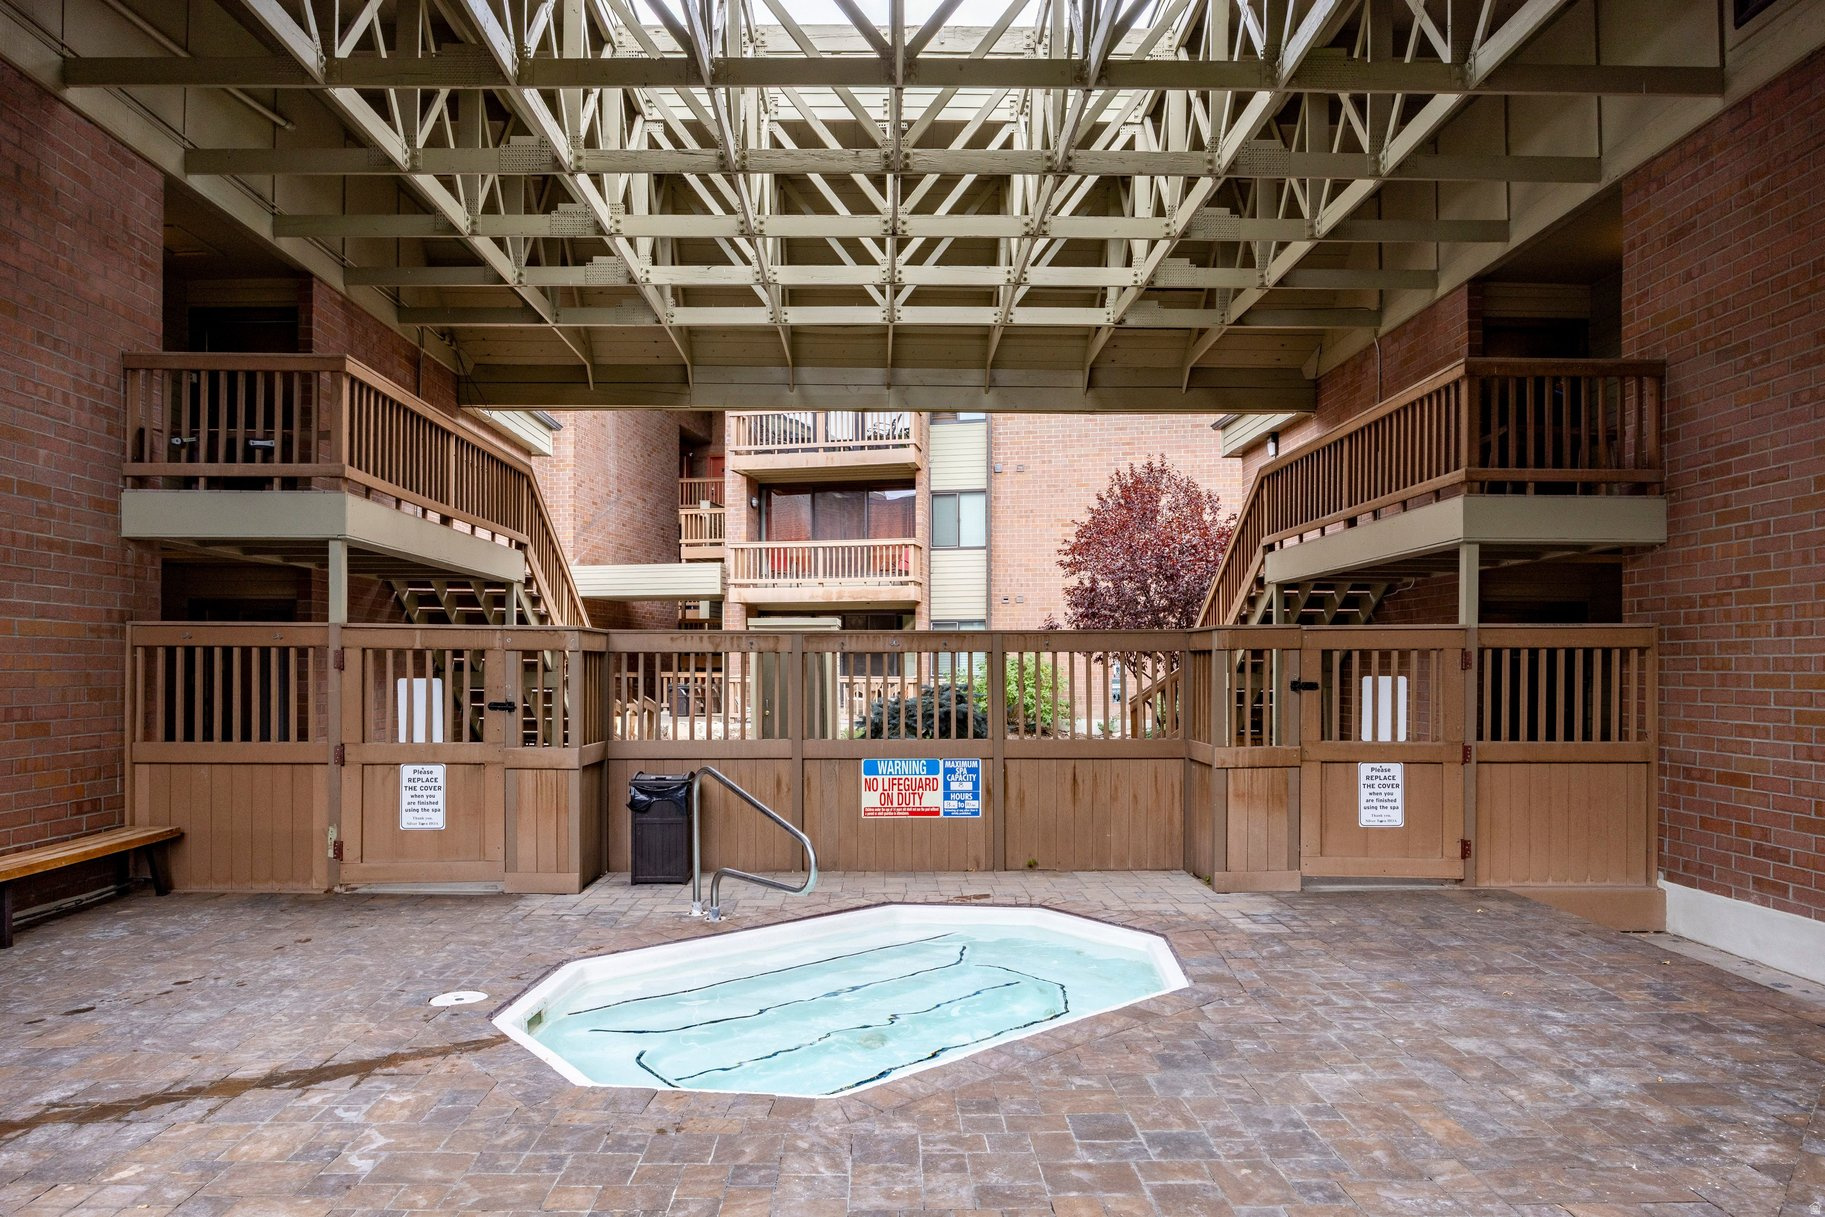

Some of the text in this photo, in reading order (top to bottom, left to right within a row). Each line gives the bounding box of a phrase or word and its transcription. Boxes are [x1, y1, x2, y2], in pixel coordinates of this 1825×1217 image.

[877, 760, 926, 774] WARNING
[864, 778, 938, 792] NO LIFEGUARD
[880, 792, 924, 806] ON DUTY
